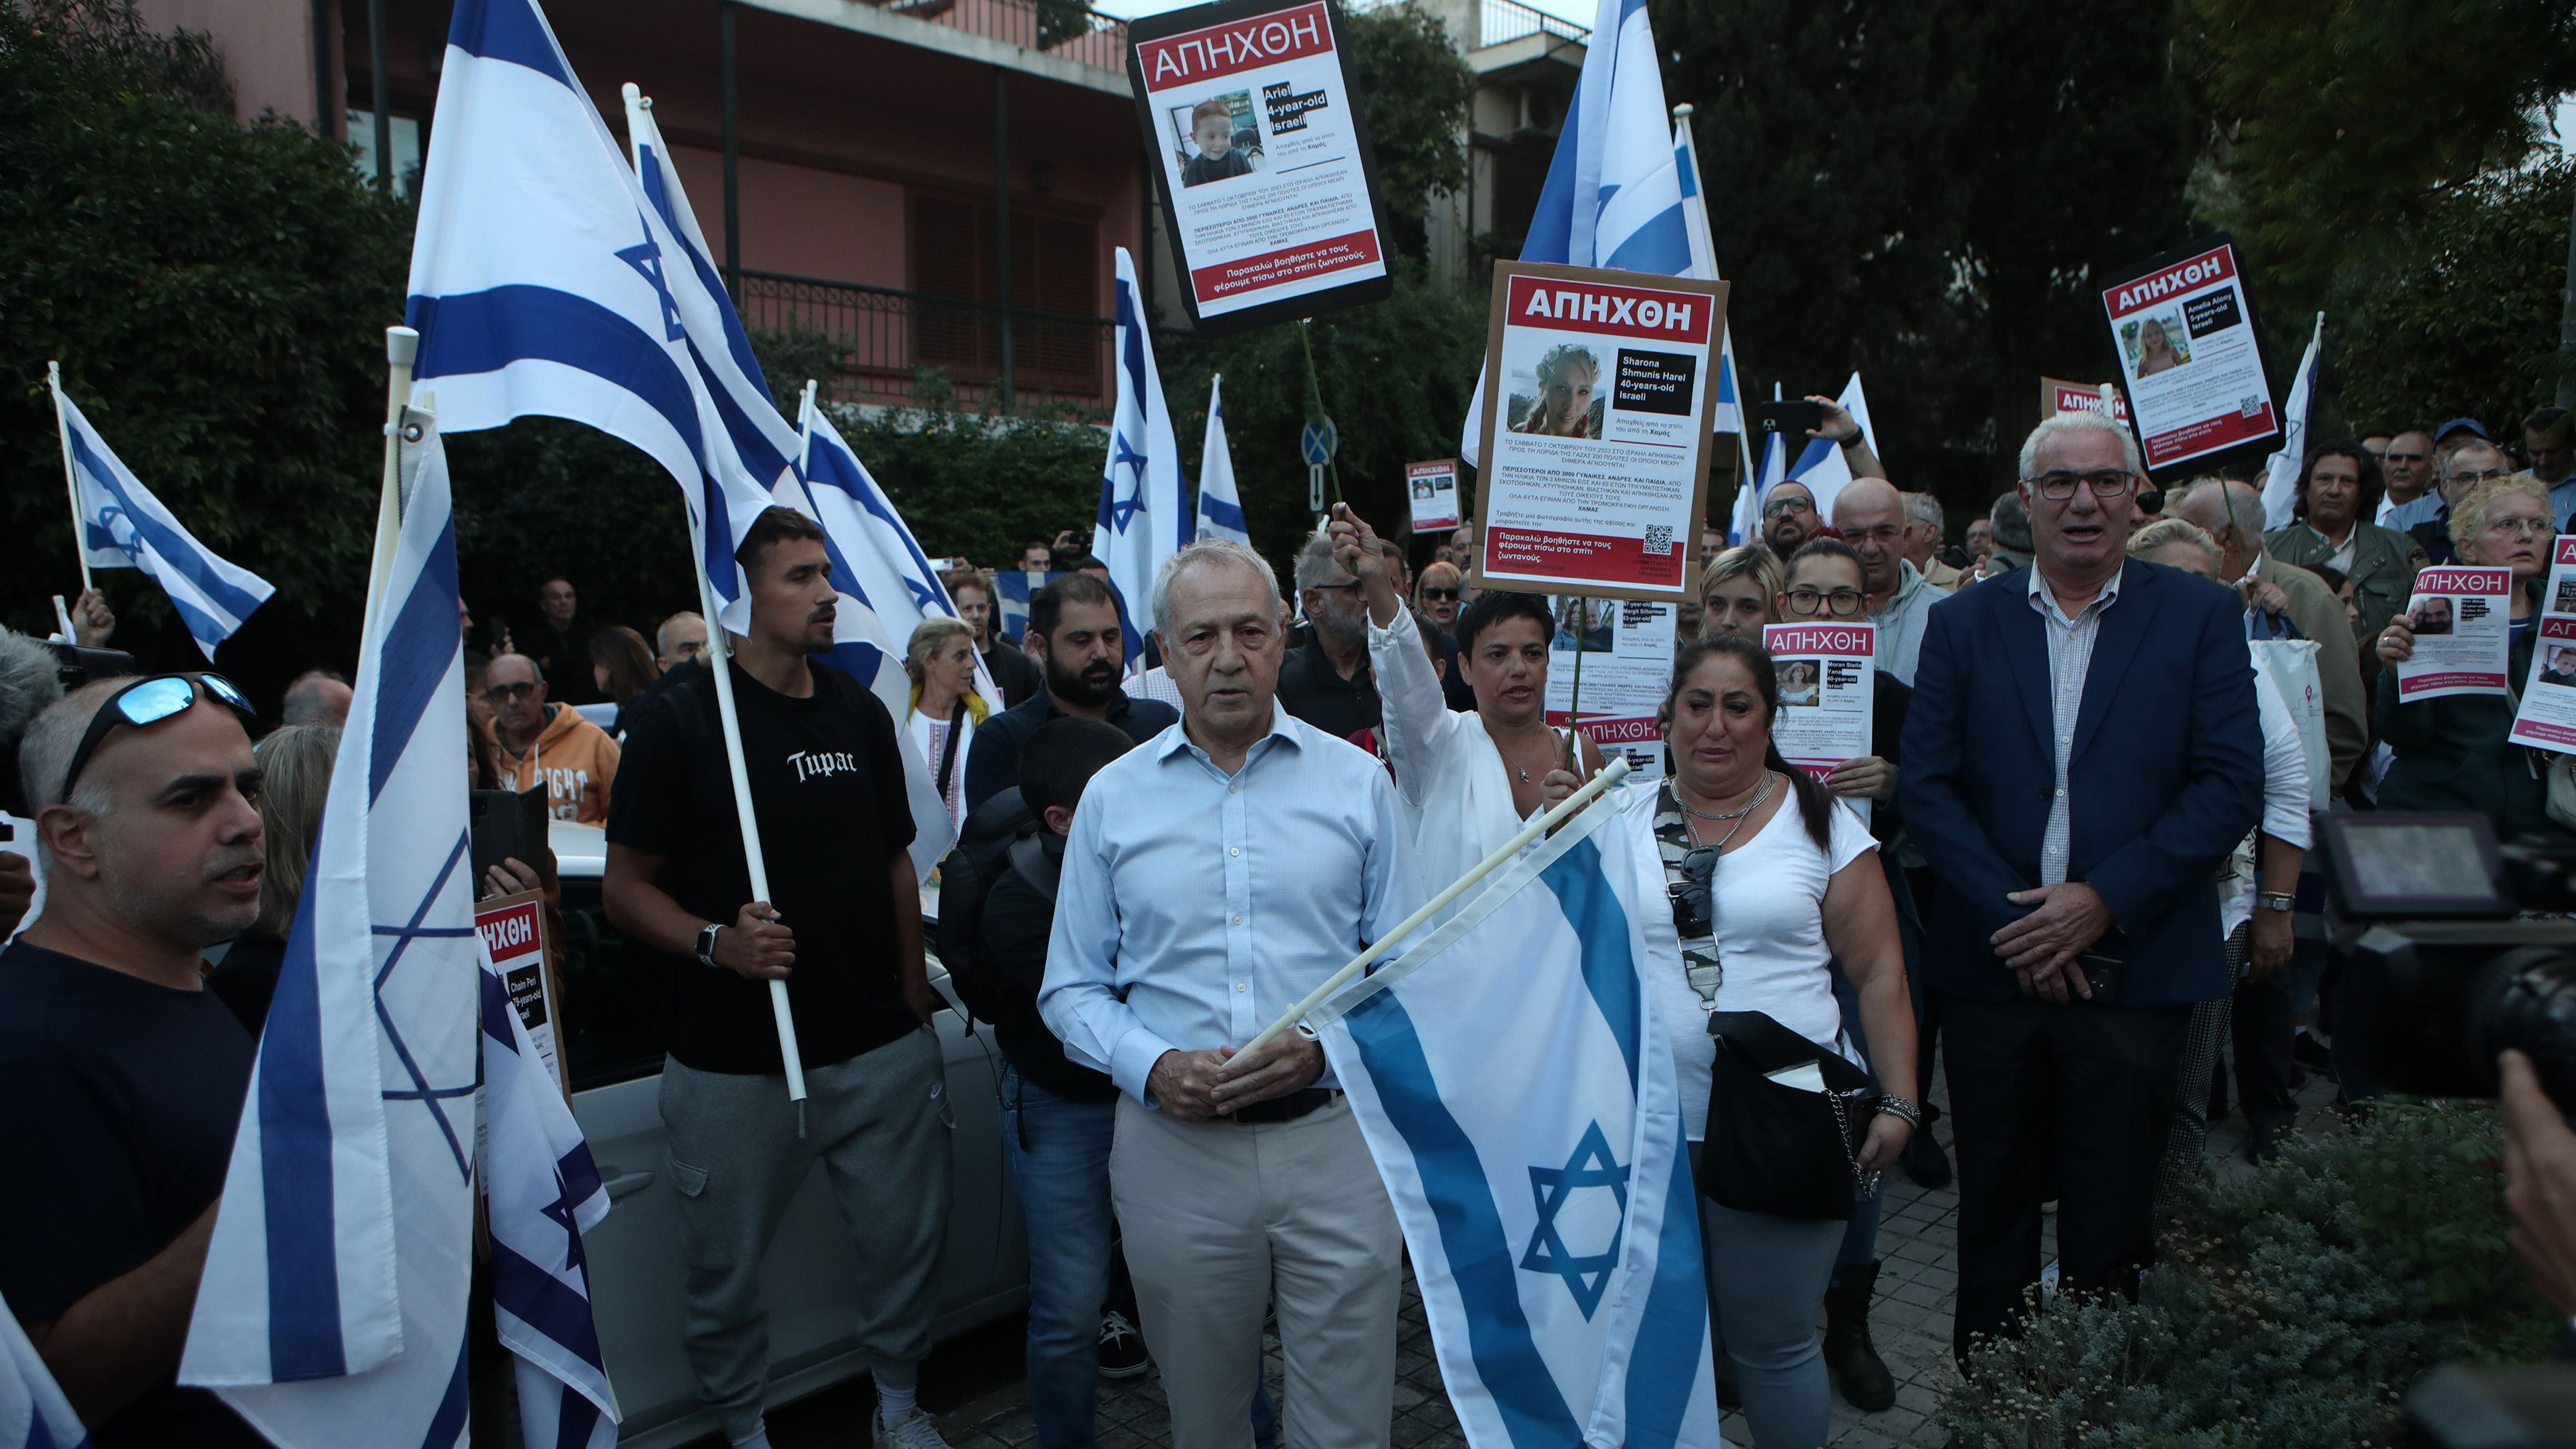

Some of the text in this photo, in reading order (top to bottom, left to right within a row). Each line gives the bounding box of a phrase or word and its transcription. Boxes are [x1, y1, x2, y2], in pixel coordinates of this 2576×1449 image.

[1155, 13, 1320, 82] ΑΠΗΧΘΗ
[1264, 84, 1291, 101] Ariel
[1267, 92, 1326, 117] 4-year-old
[1270, 113, 1307, 132] Israeli
[1196, 198, 1222, 209] ΣΑΒΒΑΤΟ
[1226, 190, 1257, 202] ΟΚΤΩΒΡΙΟΥ
[1294, 177, 1315, 186] ΙΣΡΑΗΛ
[1315, 169, 1348, 181] ΑΠΗΧΘΗΣΑΝ
[1226, 244, 1349, 278] Παρακαλώ βοηθήστε να τους
[1213, 250, 1366, 293] φέρουμε πίσω στο σπίτι ζωντανούς.
[2119, 256, 2221, 311] ΑΠΗΧΘΗ
[1525, 289, 1692, 332] ΑΠΗΧΘΗ
[1623, 356, 1660, 368] Sharona
[1621, 367, 1686, 382] Shmunis Harel
[1620, 379, 1675, 393] 40-years-old
[1619, 390, 1646, 401] Israeli
[2063, 393, 2125, 416] ΑΠΗΧΗ
[1616, 417, 1645, 428] Απαχθείς
[1514, 439, 1543, 448] ΣΑΒΒΑΤΟ
[1647, 451, 1685, 460] ΑΠΗΧΘΗΣΑΝ
[1603, 454, 1629, 462] ΠΟΛΙΤΕΣ
[1502, 465, 1546, 475] ΠΕΡΙΣΣΟΤΕΡΟΙ
[1575, 491, 1604, 500] ΟΙΚΕΙΟΥΣ
[1586, 486, 1620, 494] ΒΙΑΣΤΗΚΑΝ
[1631, 490, 1669, 499] ΑΠΗΧΘΗΣΑΝ
[1590, 499, 1637, 510] ΤΡΟΜΟΚΡΑΤΙΚΗ
[1496, 510, 1524, 518] Τραβήξτε
[1536, 513, 1573, 523] φωτογραφία
[1604, 519, 1626, 528] αφίσας
[1498, 540, 1532, 551] φέρουμε
[1533, 543, 1555, 552] πίσω
[1573, 547, 1593, 555] σπίτι
[1499, 531, 1541, 542] Παρακαλώ
[1543, 535, 1581, 547] βοηθήστε
[1594, 541, 1612, 550] τους
[1497, 550, 1542, 563] ζωντανούς.
[2415, 574, 2502, 591] ΑΠΗΧΘΗ
[1771, 631, 1866, 651] ΑΠΗΧΘΗ
[787, 750, 858, 784] Tupac
[510, 976, 537, 993] Chaim Peri
[512, 988, 542, 1008] 79-years-old
[519, 1008, 531, 1020] raeli
